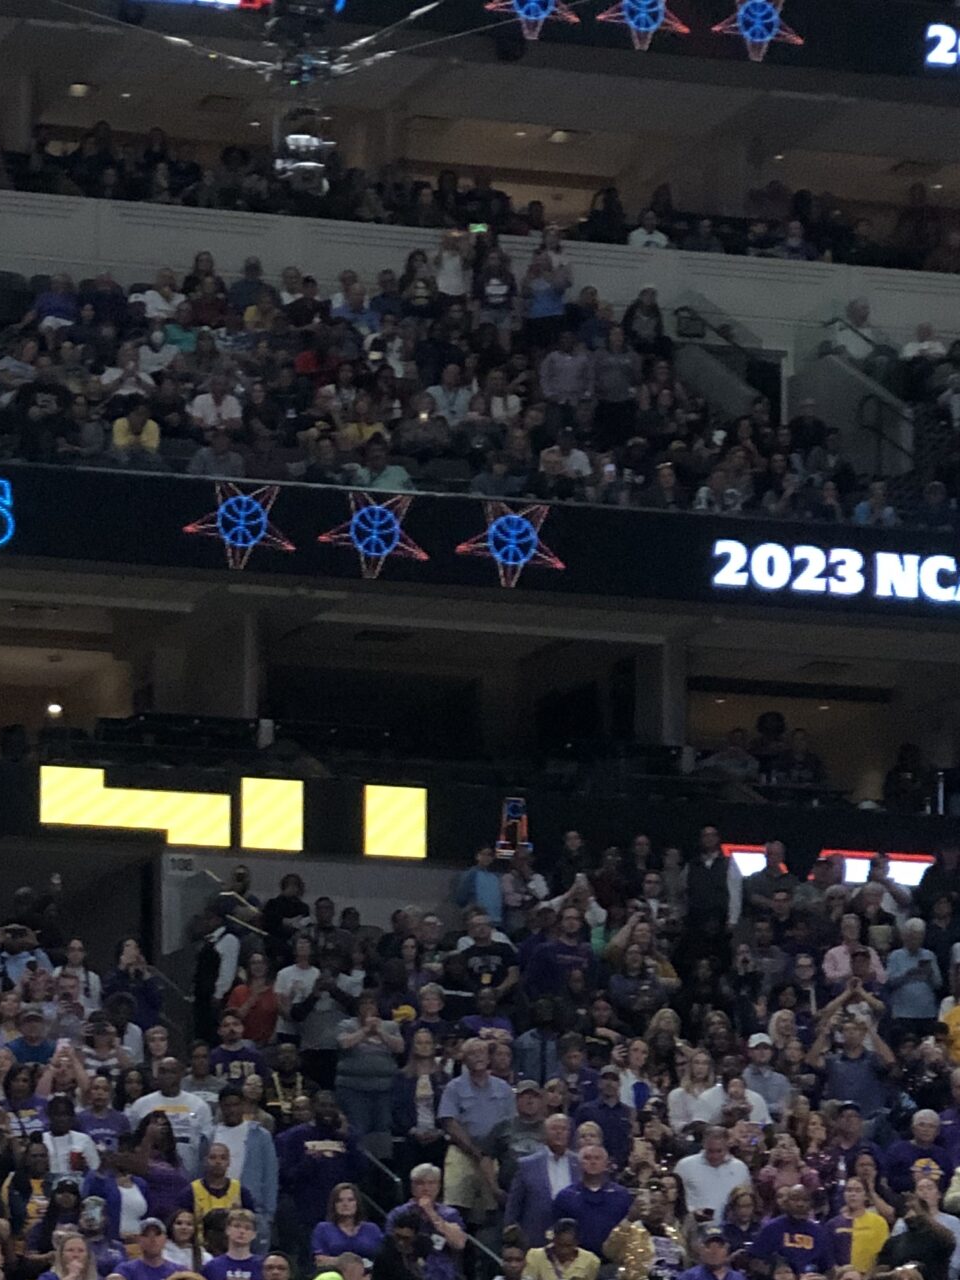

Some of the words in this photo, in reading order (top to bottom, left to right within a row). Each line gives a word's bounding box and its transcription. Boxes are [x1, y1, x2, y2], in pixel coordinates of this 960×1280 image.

[926, 23, 960, 65] 2
[713, 539, 865, 596] 2023
[874, 552, 960, 601] NC
